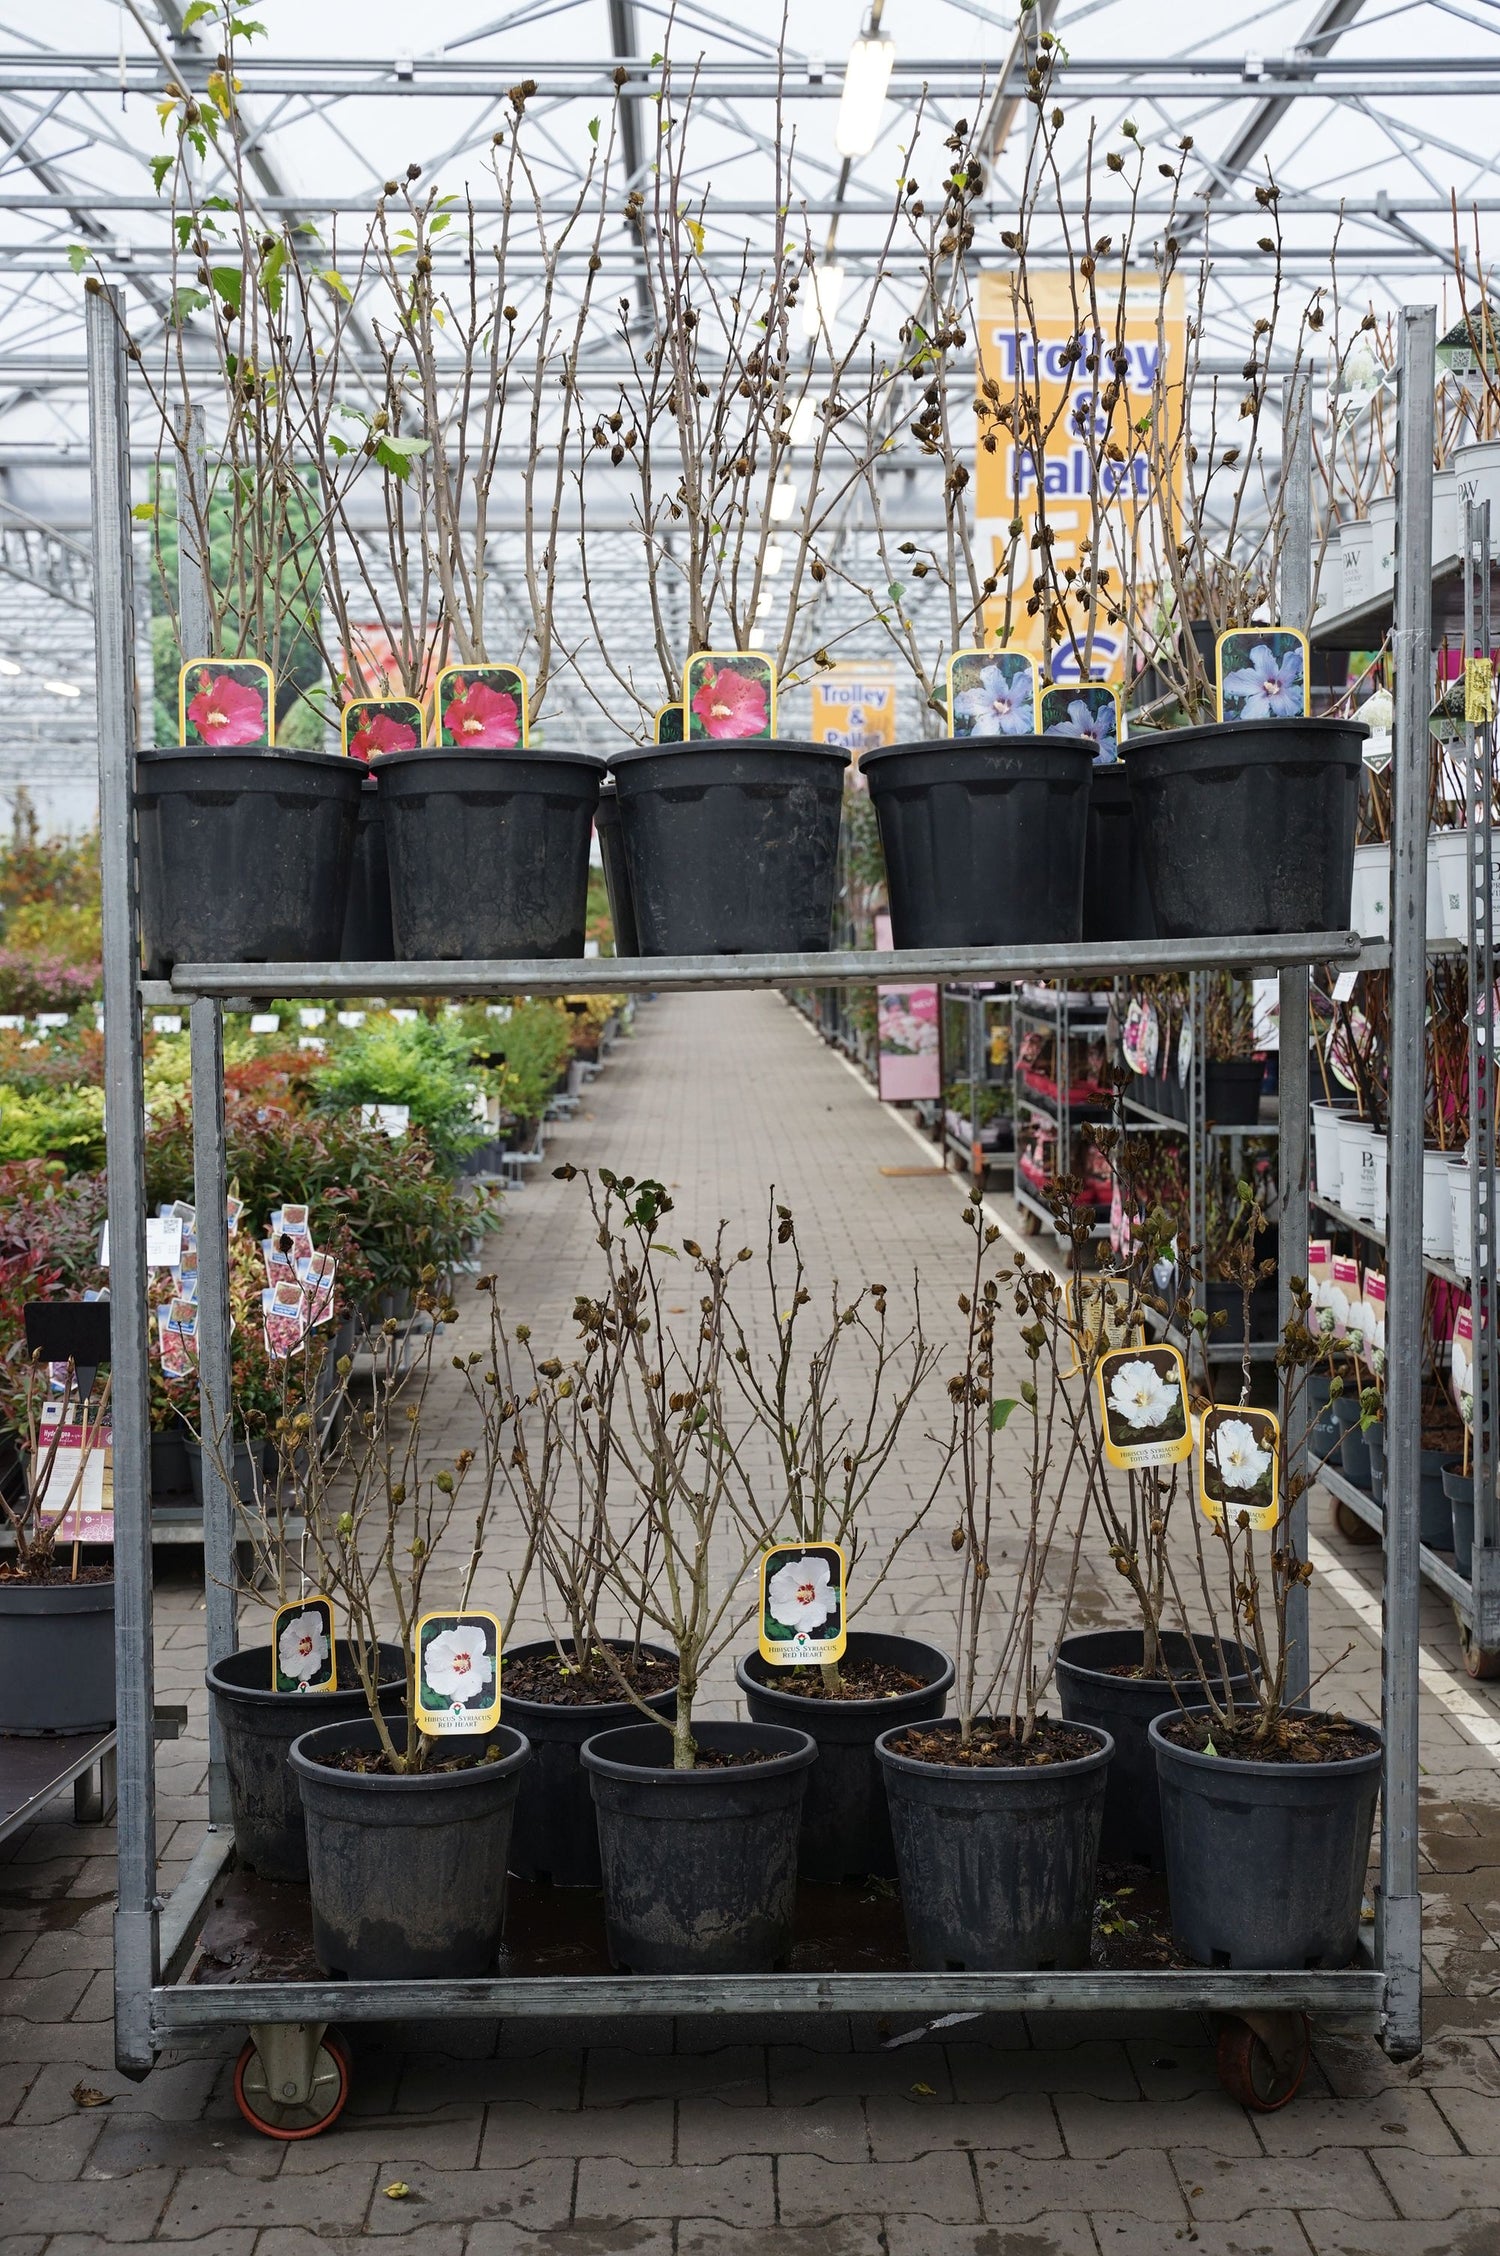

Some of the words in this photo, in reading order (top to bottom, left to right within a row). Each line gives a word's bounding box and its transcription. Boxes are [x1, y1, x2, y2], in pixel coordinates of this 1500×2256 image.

[1012, 449, 1148, 494] Palet
[821, 684, 885, 706] Trolley
[850, 709, 864, 725] &
[44, 1430, 71, 1439] Hydrgea
